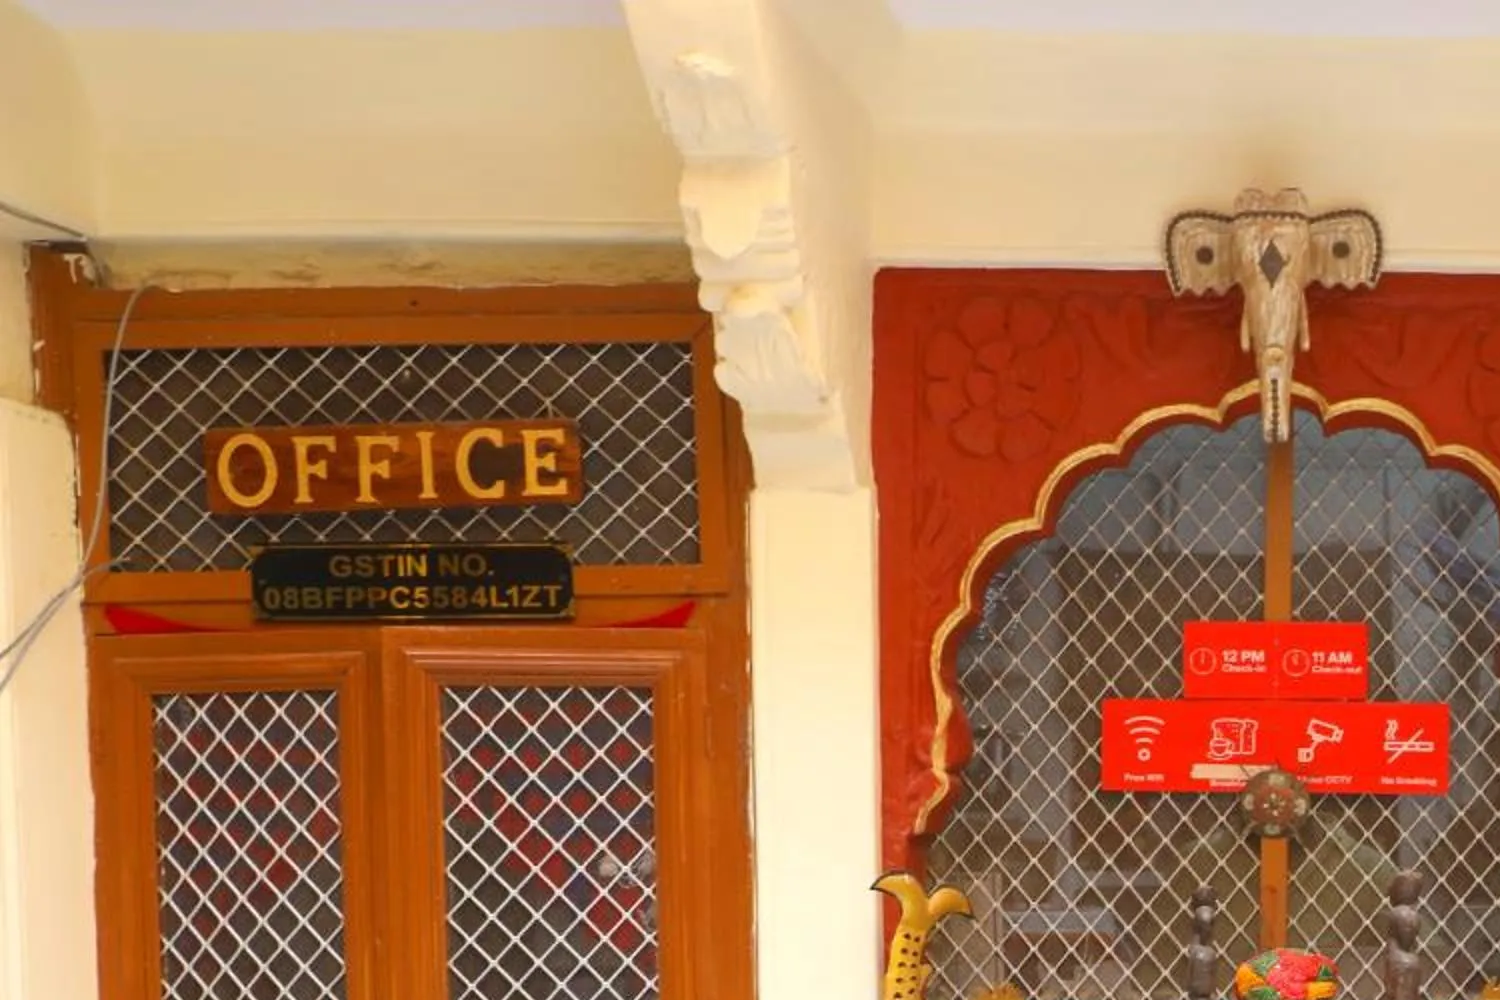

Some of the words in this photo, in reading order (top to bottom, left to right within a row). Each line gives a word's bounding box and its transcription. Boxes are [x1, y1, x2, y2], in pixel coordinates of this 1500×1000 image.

[217, 427, 568, 508] OFFICE
[328, 553, 428, 578] GSTIN
[437, 553, 495, 577] NO.
[1222, 649, 1238, 663] 12
[1240, 649, 1266, 663] PM
[1311, 651, 1325, 663] 11
[1327, 651, 1353, 664] AM
